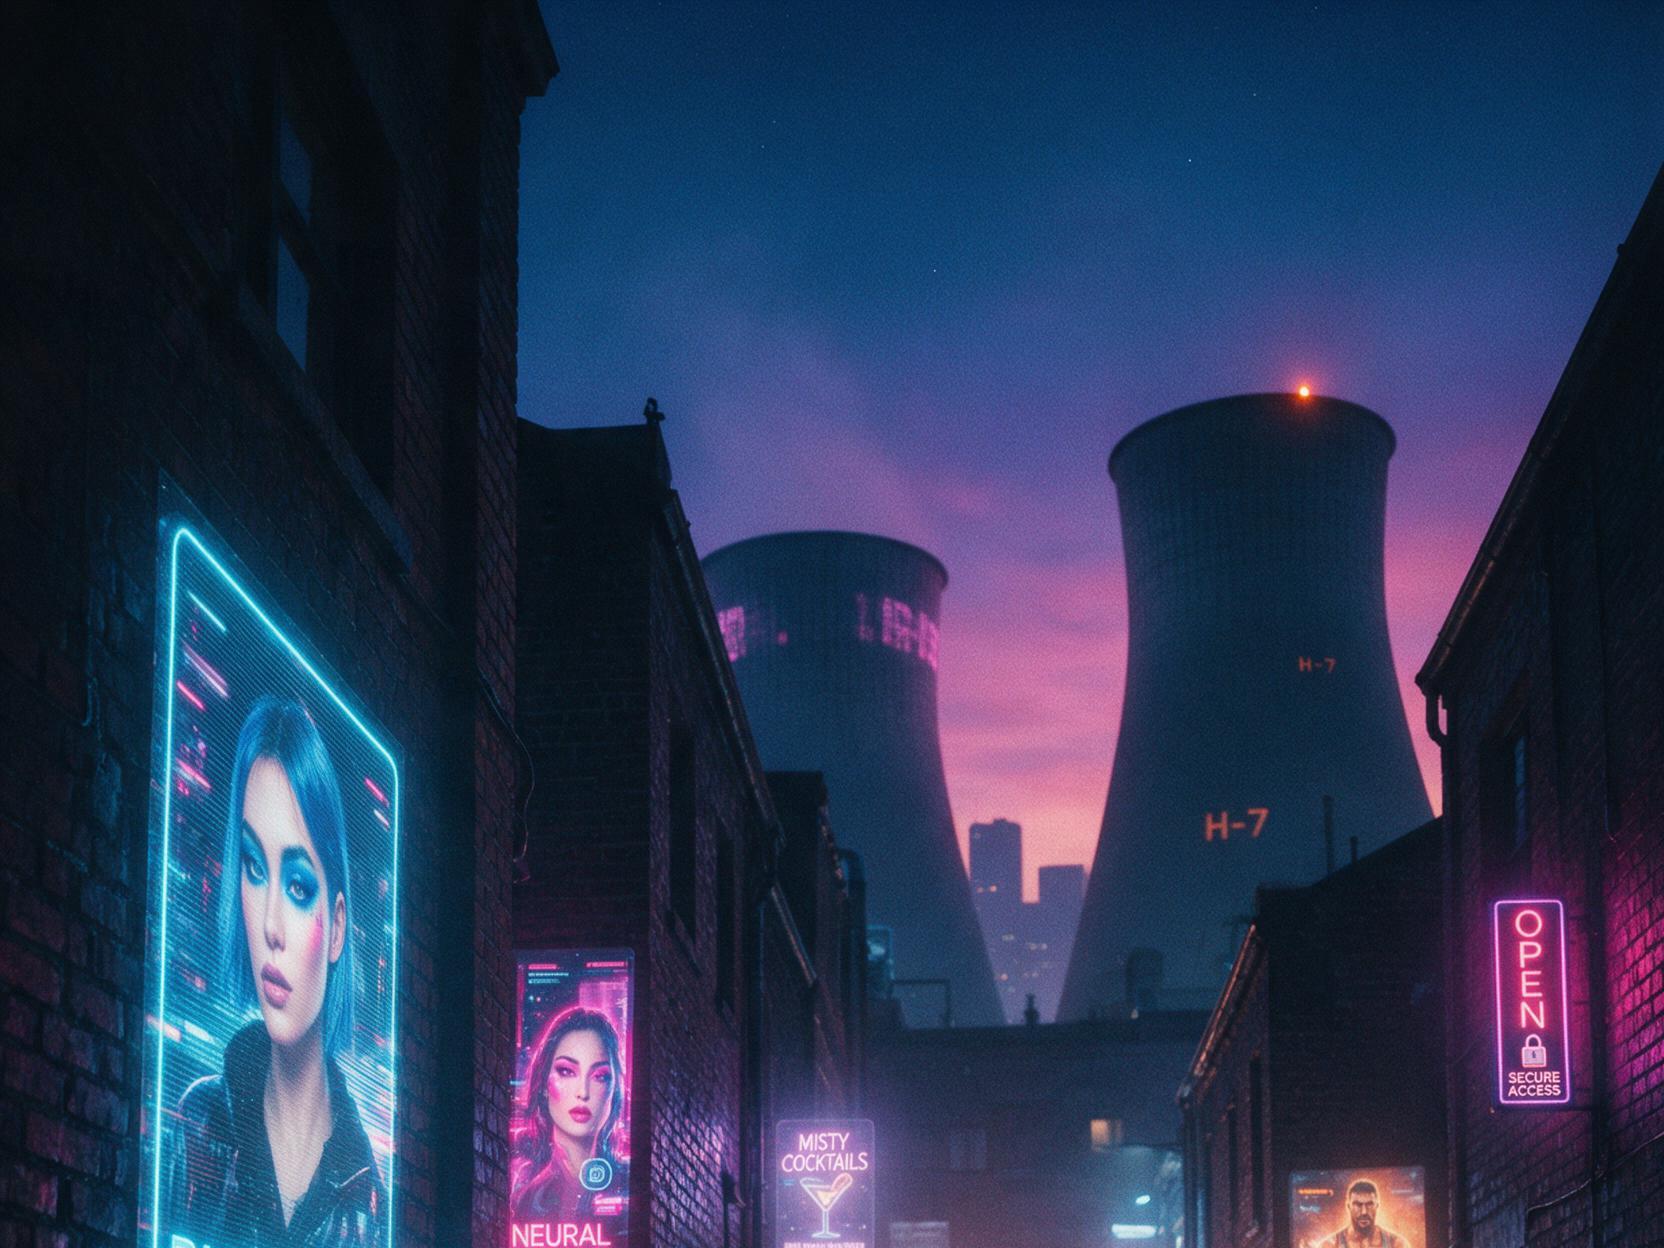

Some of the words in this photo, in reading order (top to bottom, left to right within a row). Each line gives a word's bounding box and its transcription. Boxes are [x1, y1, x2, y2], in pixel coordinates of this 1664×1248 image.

[1298, 656, 1336, 672] H-7
[1204, 808, 1269, 841] H-7
[1515, 909, 1545, 1029] OPEN
[1508, 1071, 1561, 1084] SECURE
[1508, 1084, 1561, 1097] ACCESS
[799, 1132, 850, 1151] MISTY
[781, 1152, 868, 1172] COCKTAILS
[512, 1223, 611, 1247] NEURAL
